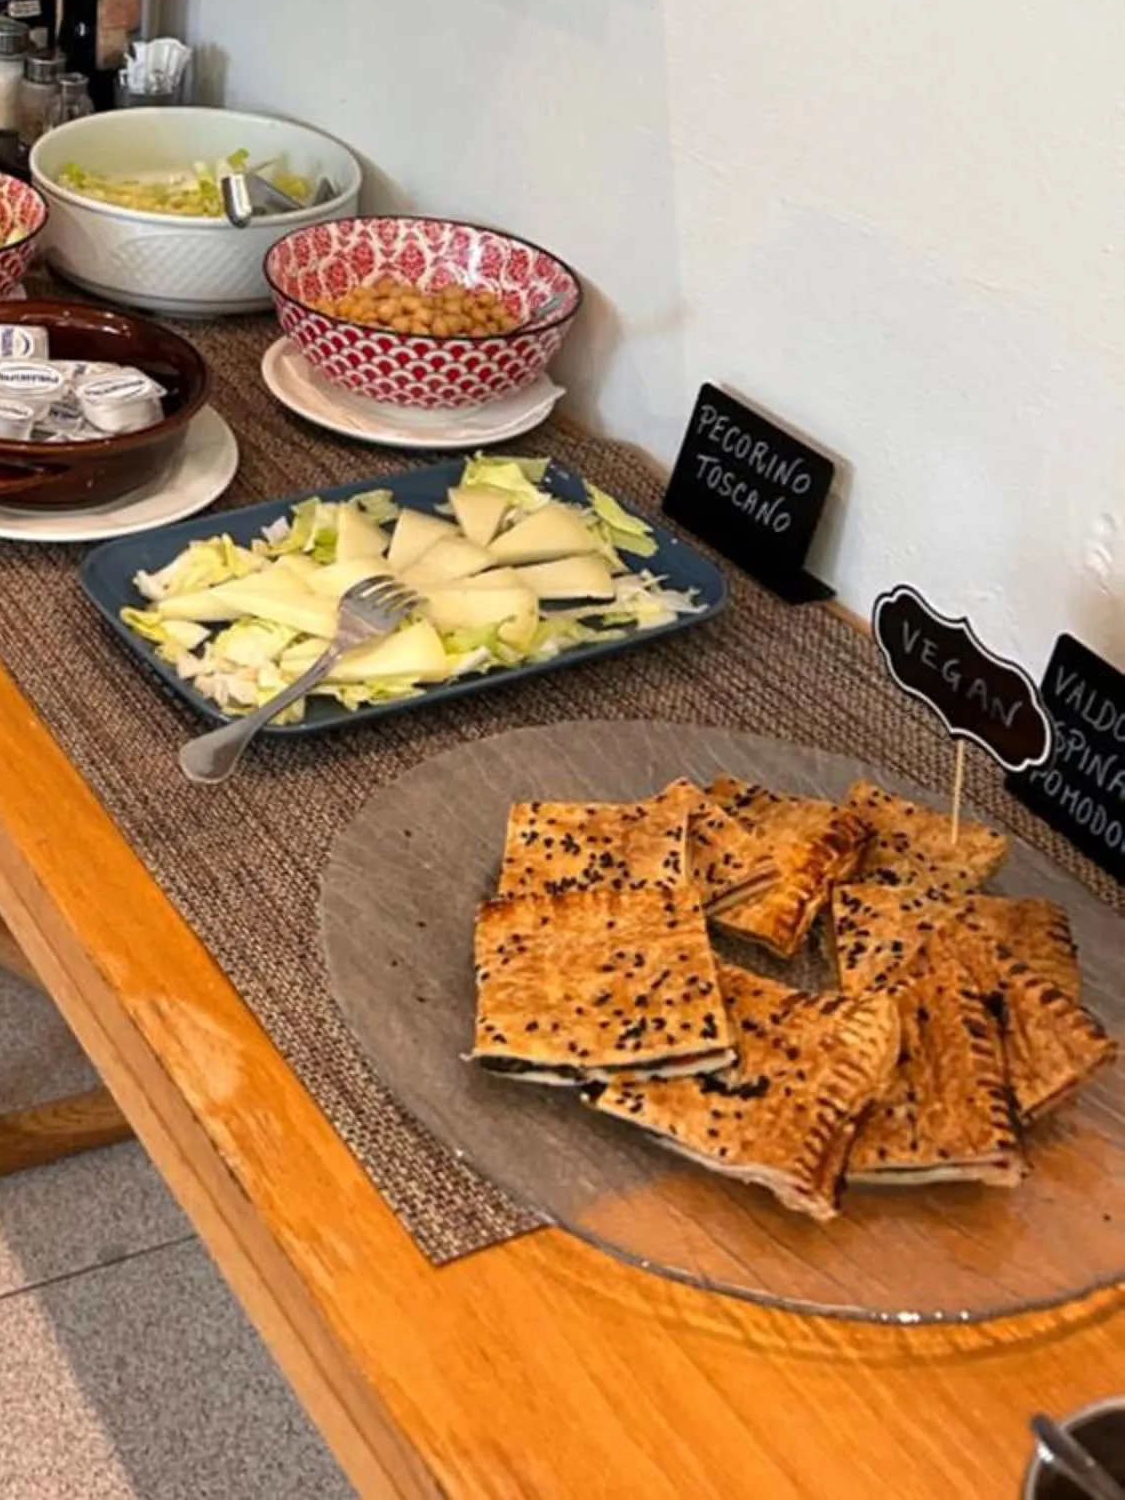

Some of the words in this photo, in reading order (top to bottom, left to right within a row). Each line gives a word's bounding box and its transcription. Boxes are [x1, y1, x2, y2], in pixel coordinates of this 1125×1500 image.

[695, 453, 792, 534] TOSCANO
[700, 403, 813, 495] PECORINO
[901, 620, 1023, 730] VEGAN
